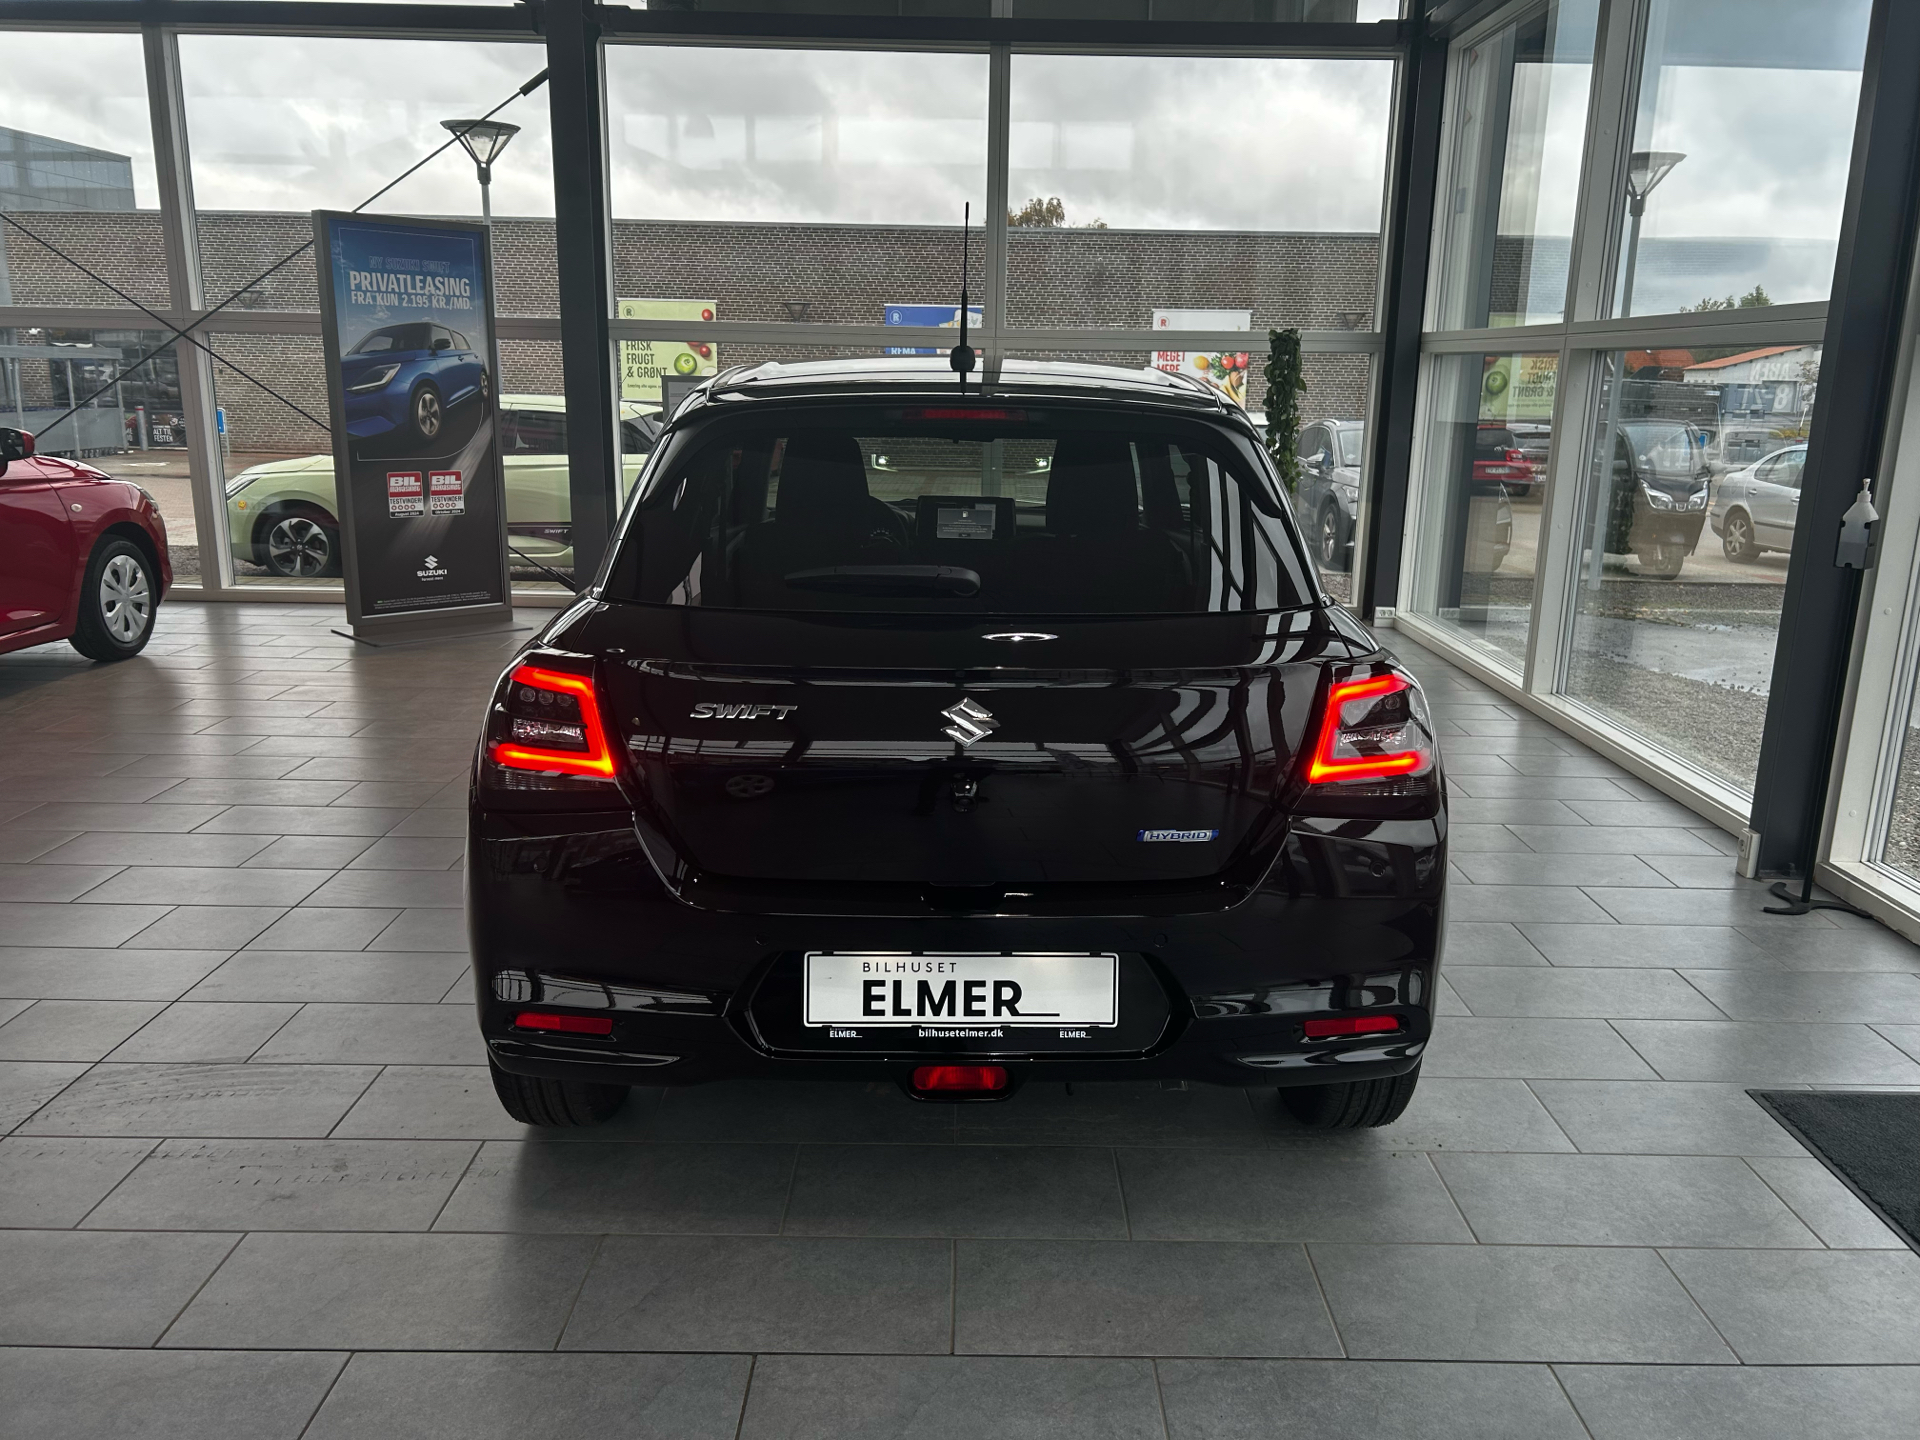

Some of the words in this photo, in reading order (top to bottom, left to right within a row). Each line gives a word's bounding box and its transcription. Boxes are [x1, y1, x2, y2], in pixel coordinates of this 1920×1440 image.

[369, 256, 382, 268] NY
[386, 257, 420, 271] SUZUKI
[422, 260, 450, 274] SWIFT
[349, 270, 470, 296] PRIVATLEASING
[351, 291, 372, 304] FRA
[376, 292, 398, 306] KUN
[401, 294, 428, 307] 2.195
[431, 295, 472, 310] KR./MD.
[626, 340, 652, 350] FRISK
[626, 353, 654, 364] FRUGT
[1157, 351, 1186, 361] MEGET
[627, 366, 634, 377] &
[637, 367, 667, 378] GRØNT
[389, 476, 420, 486] BIL
[431, 475, 462, 484] BIL
[690, 702, 798, 719] SWIFT
[1149, 831, 1208, 839] HYBRID
[862, 962, 958, 972] BILHUSET
[862, 979, 1022, 1016] ELMER
[918, 1027, 1004, 1038] bilhusetelmer.dk
